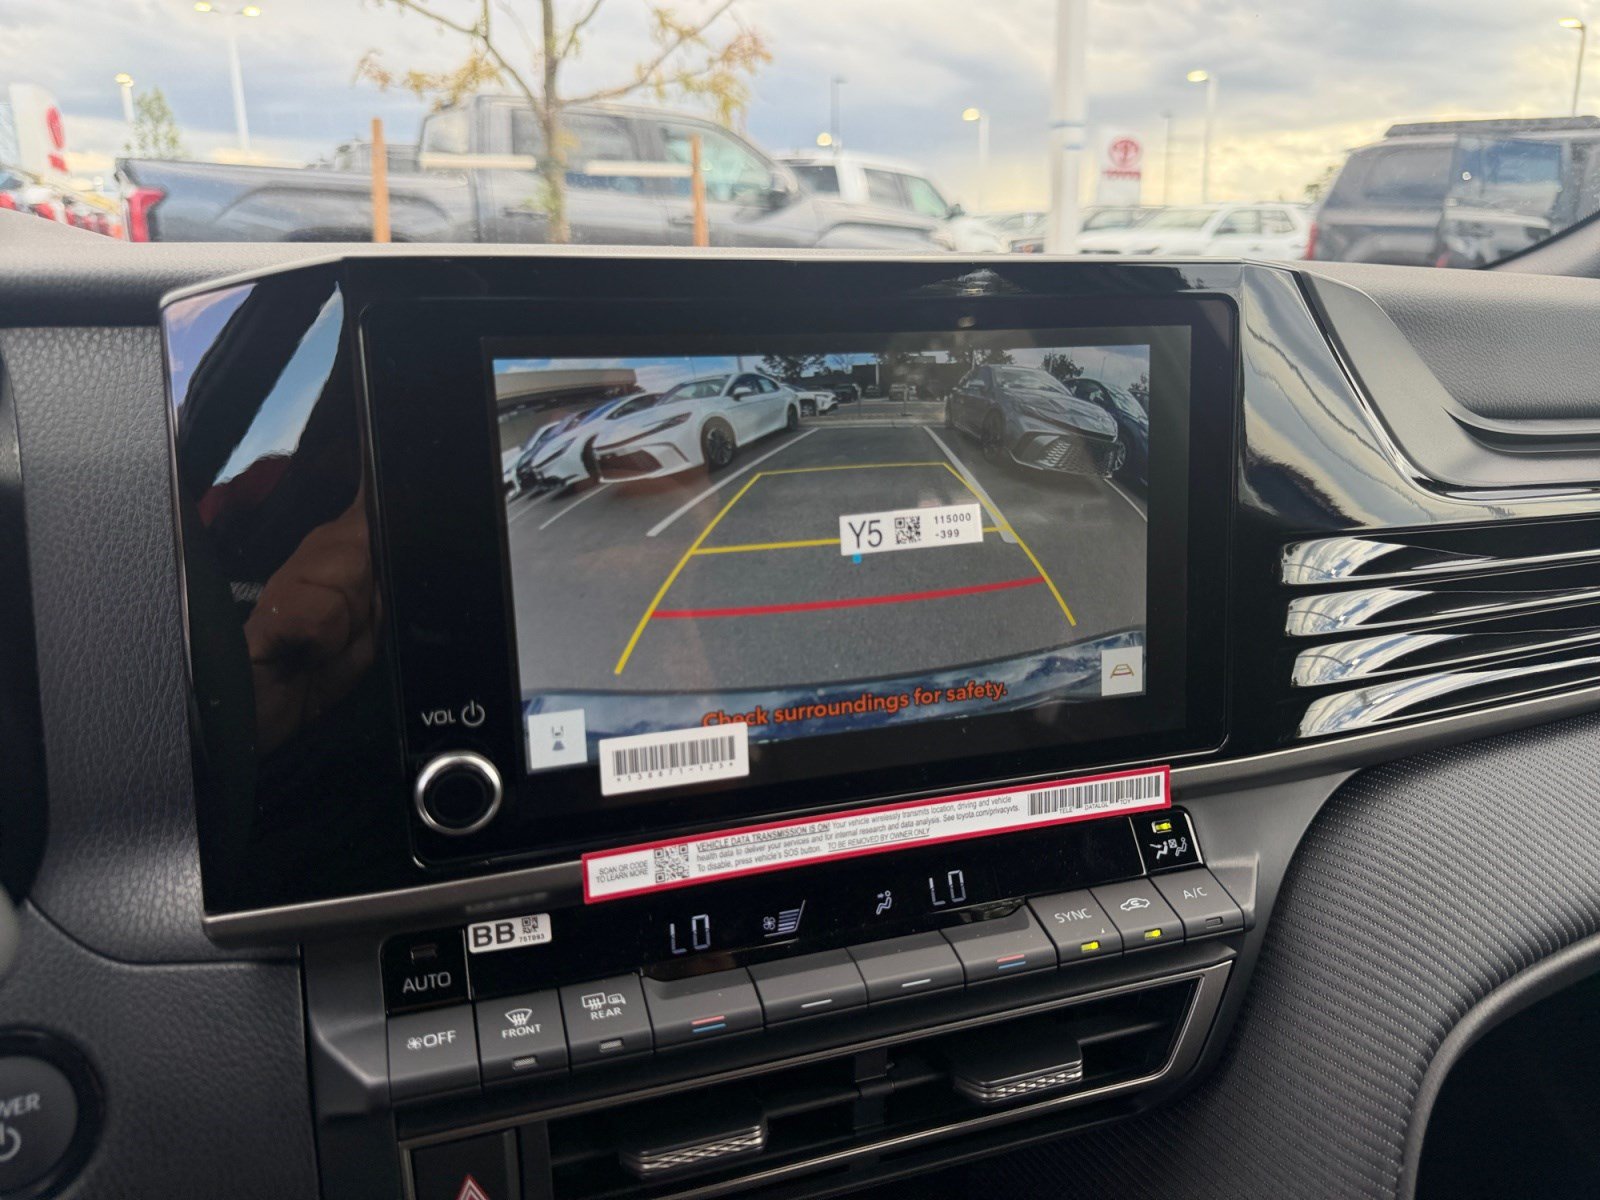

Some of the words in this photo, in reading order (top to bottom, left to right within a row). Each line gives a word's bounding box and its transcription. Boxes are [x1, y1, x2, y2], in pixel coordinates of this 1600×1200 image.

[934, 512, 972, 525] 115000
[848, 519, 883, 549] Y5
[935, 528, 960, 540] -399
[702, 706, 768, 726] Check
[774, 692, 909, 723] surroundings
[913, 687, 941, 705] for
[946, 680, 1008, 705] safety.
[421, 709, 456, 727] VOL
[696, 838, 729, 851] VEHICLE
[731, 835, 750, 846] DATA
[751, 825, 806, 842] TRANSMISSION
[832, 820, 845, 829] Your
[848, 816, 869, 827] vehicle
[871, 812, 900, 824] wirelessly
[902, 807, 928, 818] transmits
[957, 800, 976, 811] driving
[978, 798, 989, 807] and
[991, 795, 1011, 805] vehicle
[696, 851, 717, 861] health
[719, 848, 733, 858] data
[744, 843, 766, 853] deliver
[767, 842, 781, 851] your
[783, 837, 809, 847] services
[810, 834, 823, 842] and
[834, 828, 857, 838] internal
[859, 824, 886, 834] research
[887, 822, 899, 830] and
[900, 820, 913, 828] data
[915, 815, 940, 827] analysis.
[942, 813, 954, 821] See
[827, 841, 836, 849] TO
[837, 839, 846, 848] BE
[847, 834, 878, 846] REMOVED
[889, 829, 913, 840] OWNER
[914, 826, 929, 836] ONLY
[734, 856, 752, 866] press
[783, 847, 798, 857] SOS
[596, 874, 606, 883] TO
[607, 871, 628, 881] LEARN
[629, 867, 648, 877] MORE
[599, 865, 617, 875] SCAN
[629, 859, 647, 869] CODE
[1182, 887, 1208, 901] A/C
[1054, 908, 1093, 924] SYNC
[472, 922, 515, 948] BB
[402, 971, 452, 994] AUTO
[590, 1006, 623, 1021] REAR
[423, 1030, 457, 1049] OFF
[501, 1023, 542, 1039] FRONT
